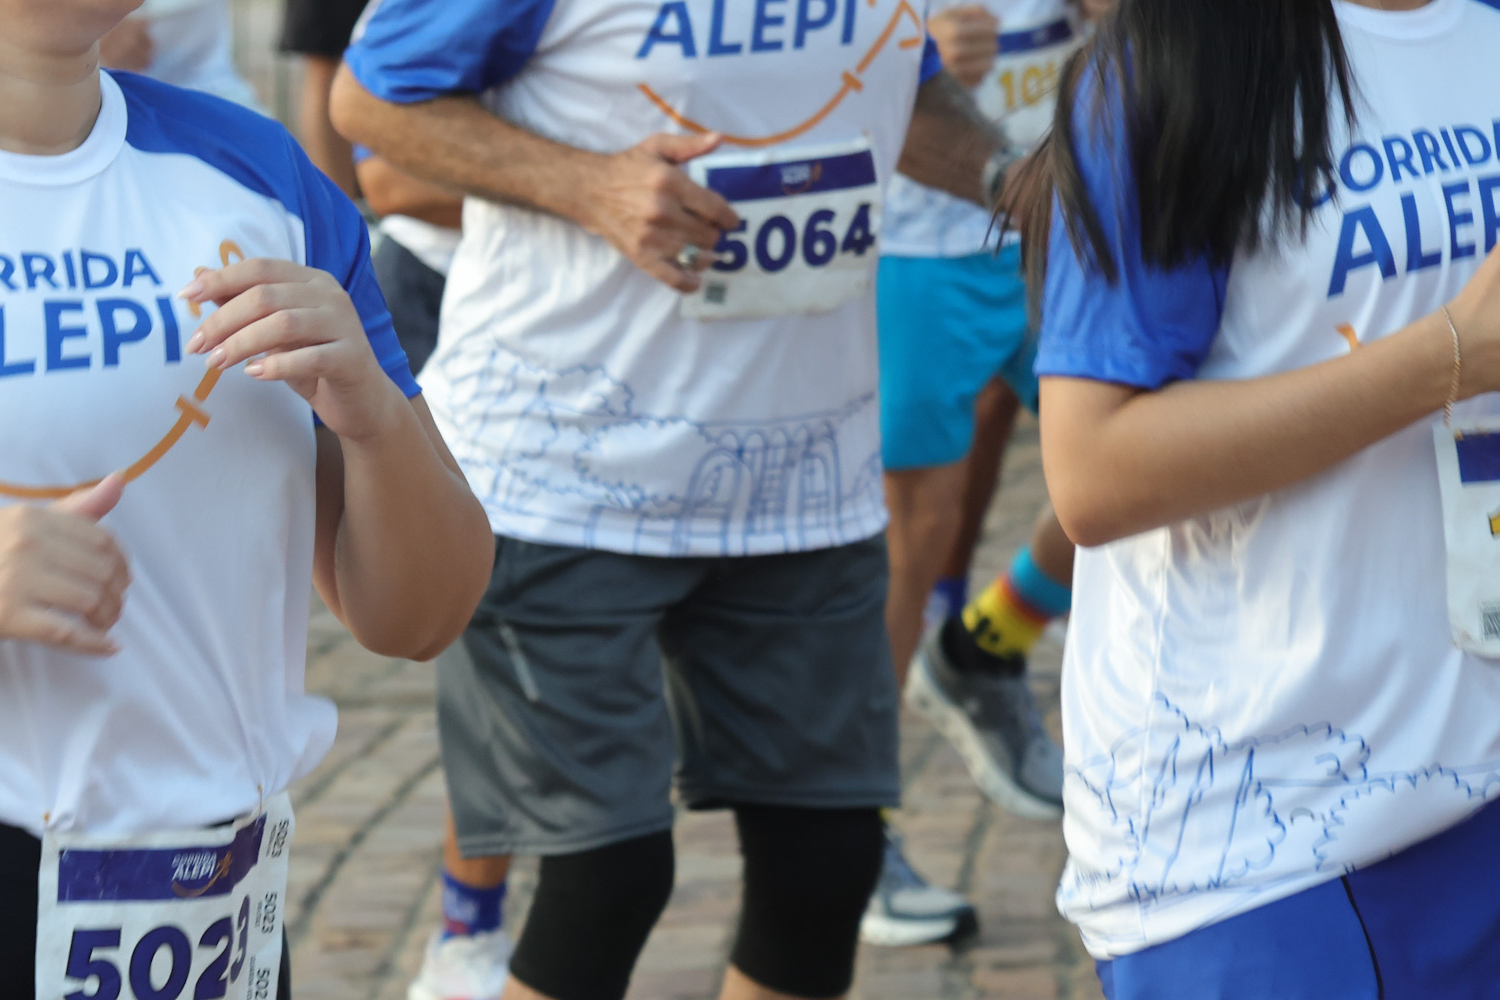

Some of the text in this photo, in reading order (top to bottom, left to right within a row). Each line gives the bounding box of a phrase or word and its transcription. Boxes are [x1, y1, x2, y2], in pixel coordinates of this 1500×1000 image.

[711, 202, 876, 276] 5064
[170, 861, 216, 882] ALEPI
[261, 890, 278, 935] 5023
